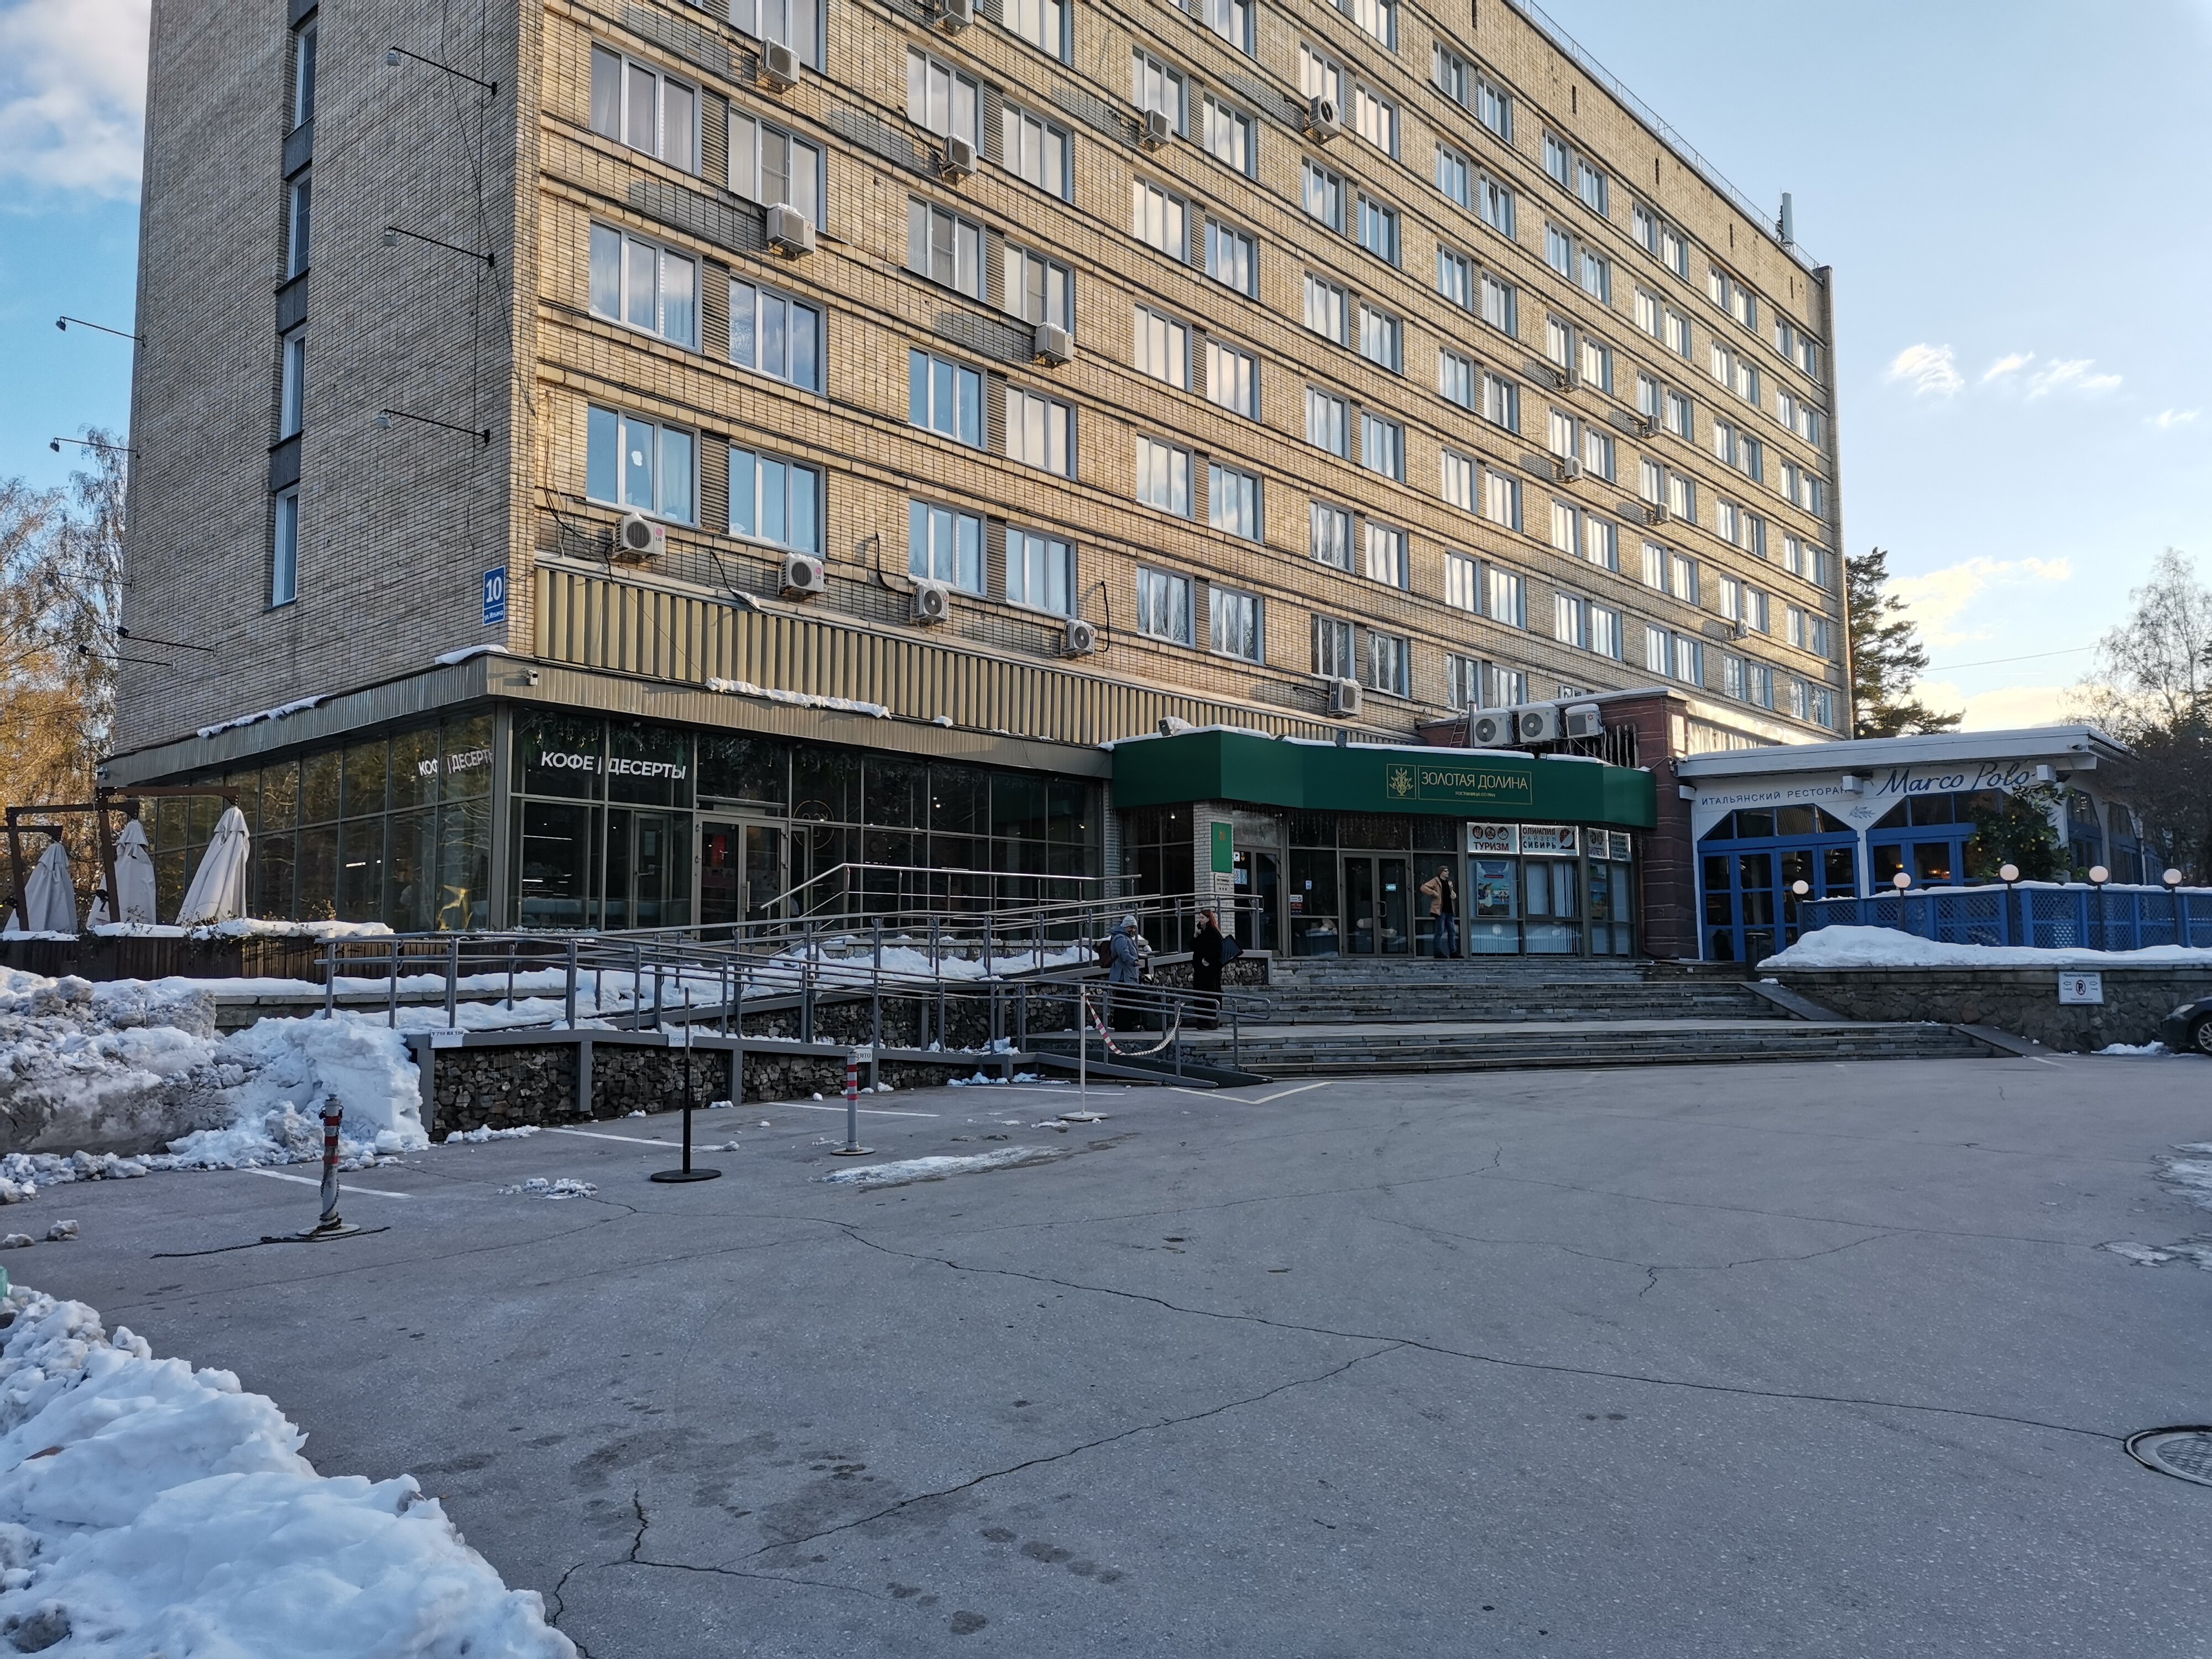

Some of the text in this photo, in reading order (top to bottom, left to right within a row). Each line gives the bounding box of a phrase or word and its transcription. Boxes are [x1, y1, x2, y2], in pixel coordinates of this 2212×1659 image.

[486, 577, 502, 603] 10
[419, 758, 438, 776] КОФ
[541, 751, 686, 780] КОФЕ ДЕСЕРТЫ
[1421, 772, 1528, 790] ЗОЛОТАЯ ДОЛИНА
[1876, 760, 2037, 796] Marco Polo
[1702, 791, 1780, 805] ИТАЛЬЯНСКИЙ
[1473, 842, 1509, 851] ТУРИЗМ
[1523, 841, 1556, 849] СИБИРЬ
